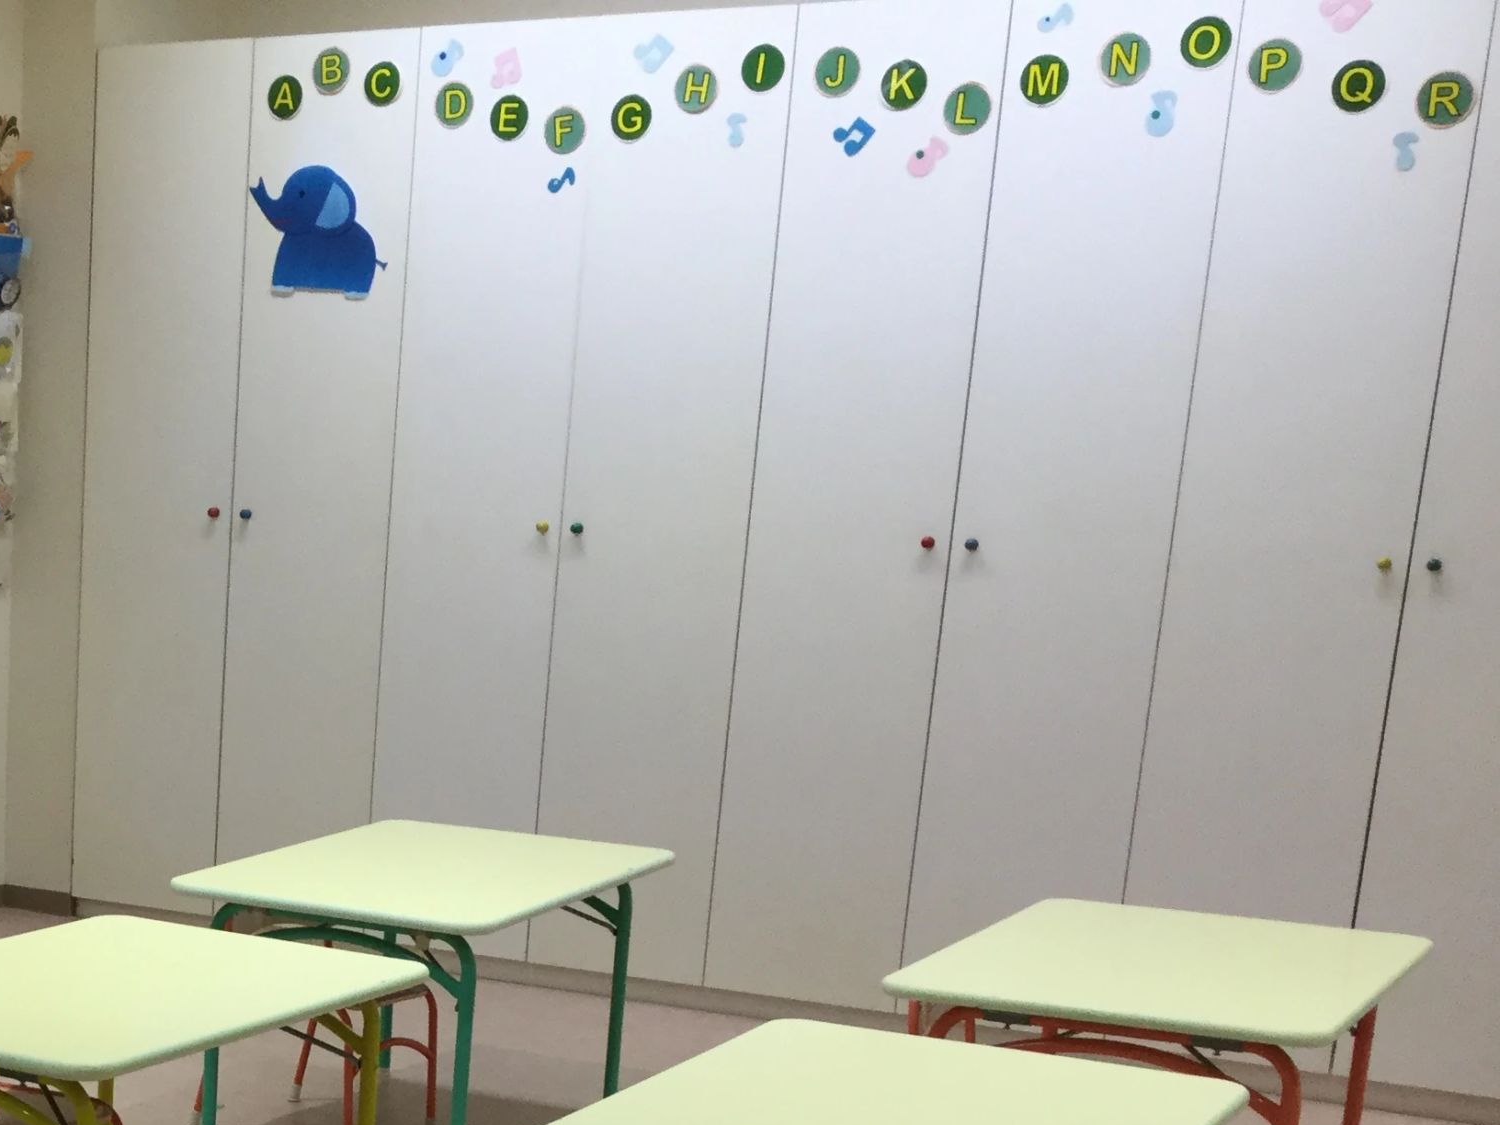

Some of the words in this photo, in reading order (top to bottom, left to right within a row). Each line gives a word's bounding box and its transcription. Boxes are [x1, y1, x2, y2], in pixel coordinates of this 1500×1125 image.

[274, 81, 295, 111] A
[321, 54, 343, 86] B
[369, 68, 392, 98] C
[443, 89, 467, 120] D
[498, 102, 520, 133] E
[554, 114, 574, 147] F
[617, 102, 642, 134] G
[684, 73, 711, 104] H
[755, 52, 766, 84] I
[824, 56, 846, 88] J
[889, 68, 918, 100] K
[954, 93, 977, 126] L
[1027, 63, 1060, 96] M
[1110, 43, 1138, 75] N
[1188, 25, 1221, 59] O
[1258, 46, 1288, 82] P
[1340, 67, 1374, 103] Q
[1427, 80, 1460, 118] R
